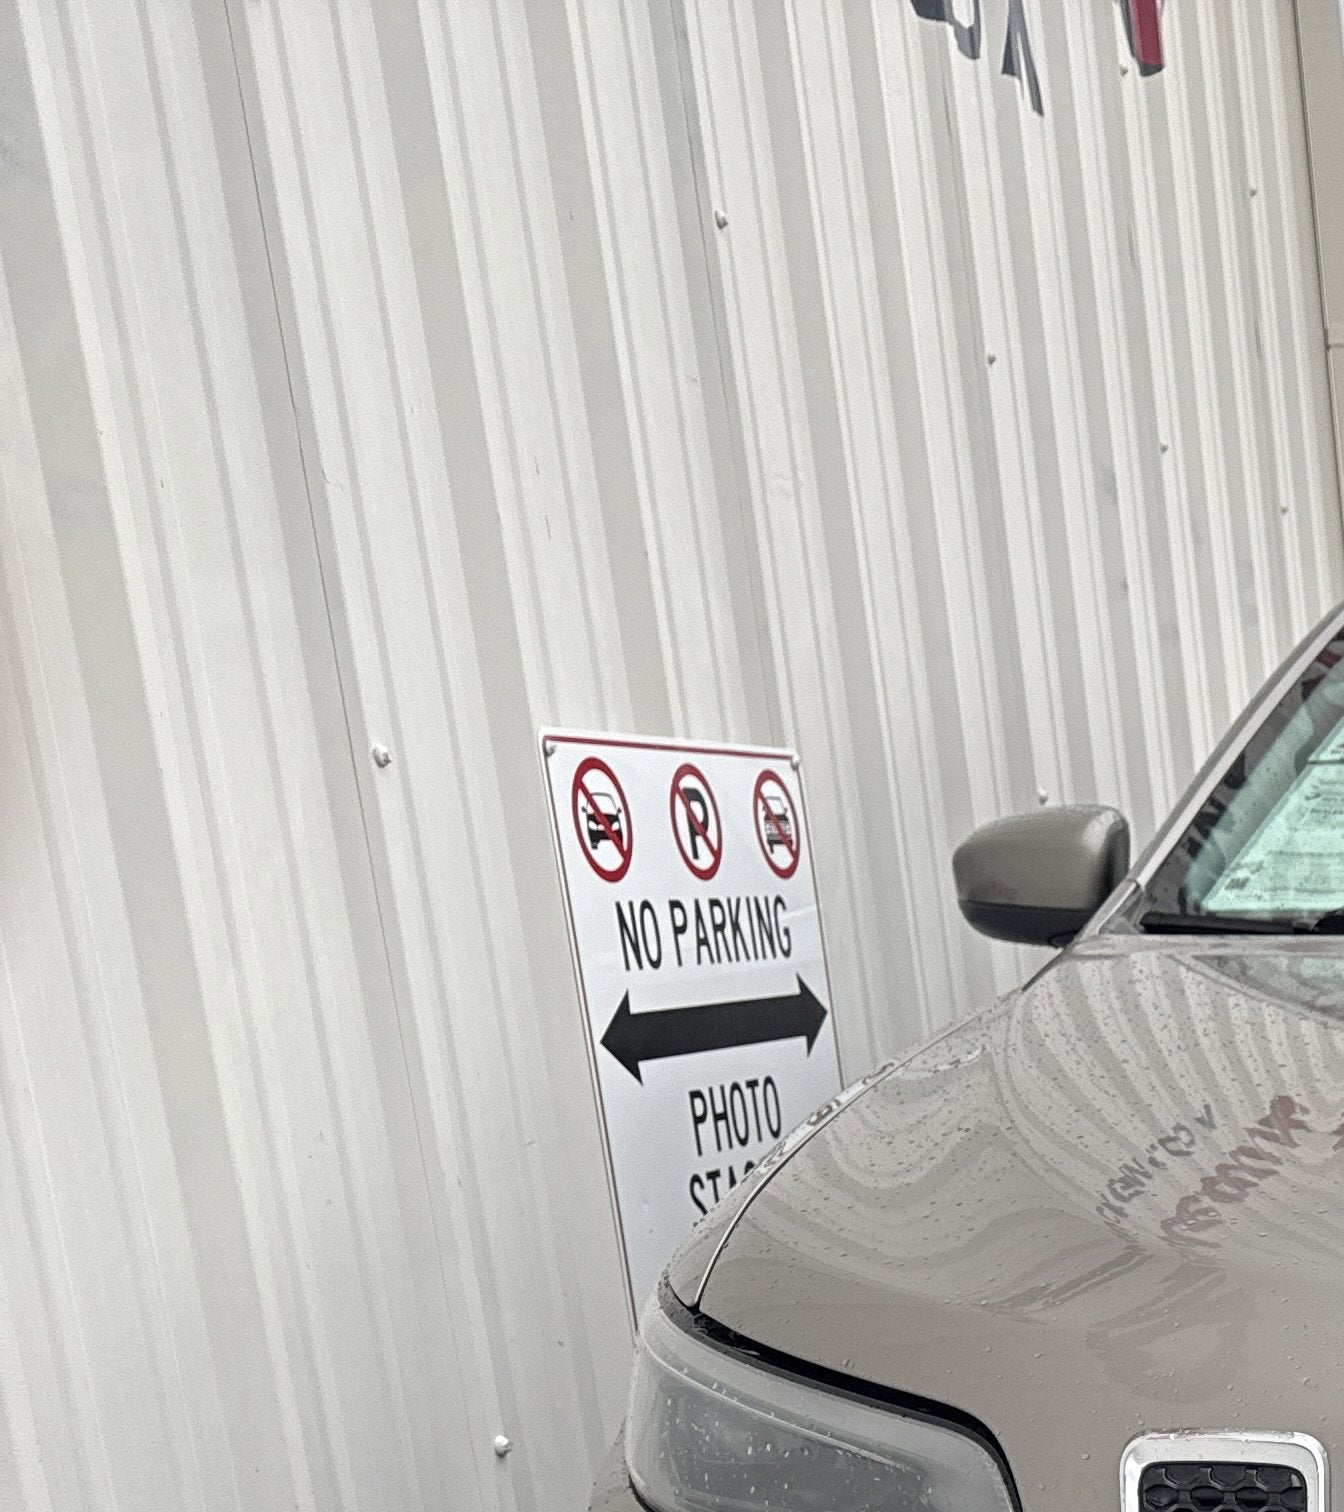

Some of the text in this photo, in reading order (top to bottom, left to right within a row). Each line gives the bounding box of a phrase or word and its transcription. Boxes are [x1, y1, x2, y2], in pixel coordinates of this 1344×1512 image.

[615, 894, 792, 971] NO PARKING
[688, 1075, 782, 1157] PHOTO
[689, 1160, 755, 1216] ST
